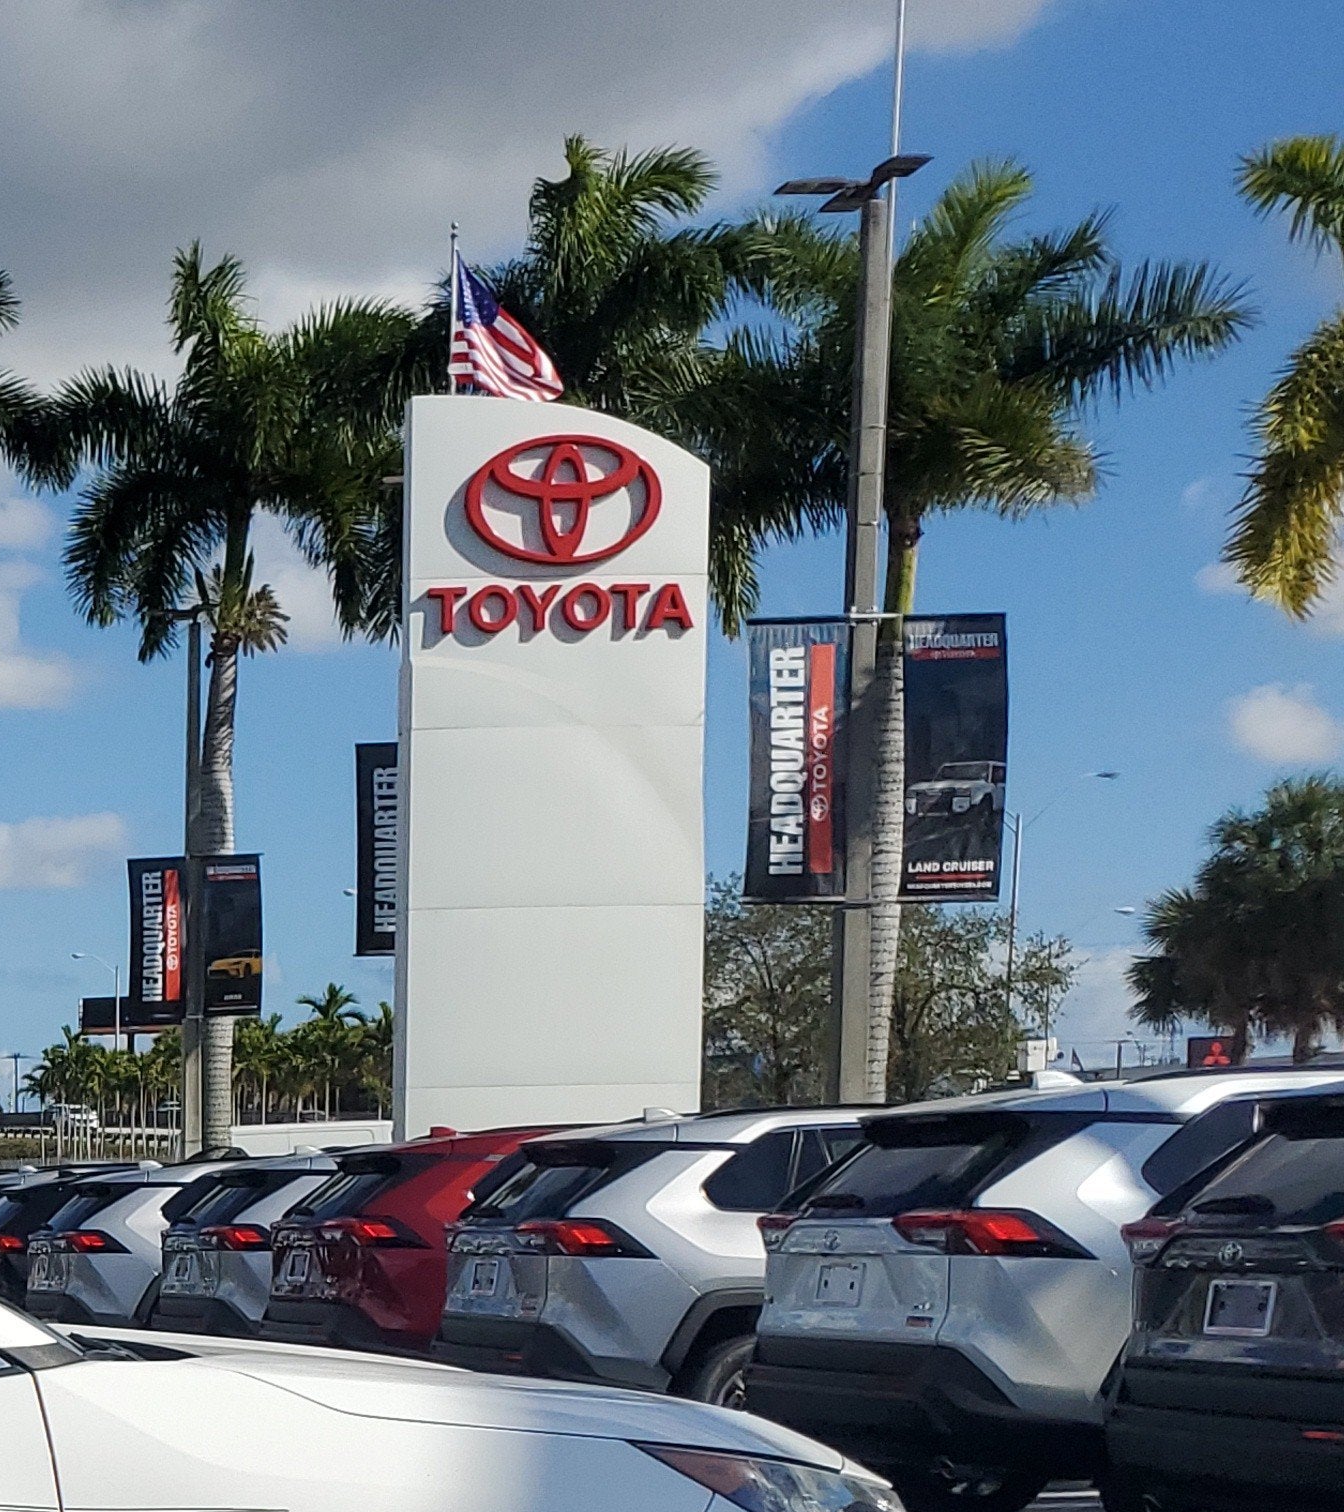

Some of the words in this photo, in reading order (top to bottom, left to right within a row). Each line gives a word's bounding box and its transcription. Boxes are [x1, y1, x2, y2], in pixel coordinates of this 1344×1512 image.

[428, 582, 694, 634] TOYOTA
[769, 646, 808, 875] HEADQUARTER
[813, 706, 829, 792] TOYOTA
[374, 767, 398, 932] HEADQUARTER
[907, 861, 940, 873] LAND
[942, 860, 994, 872] CRUISER
[142, 871, 165, 1002] HEADQUARTER
